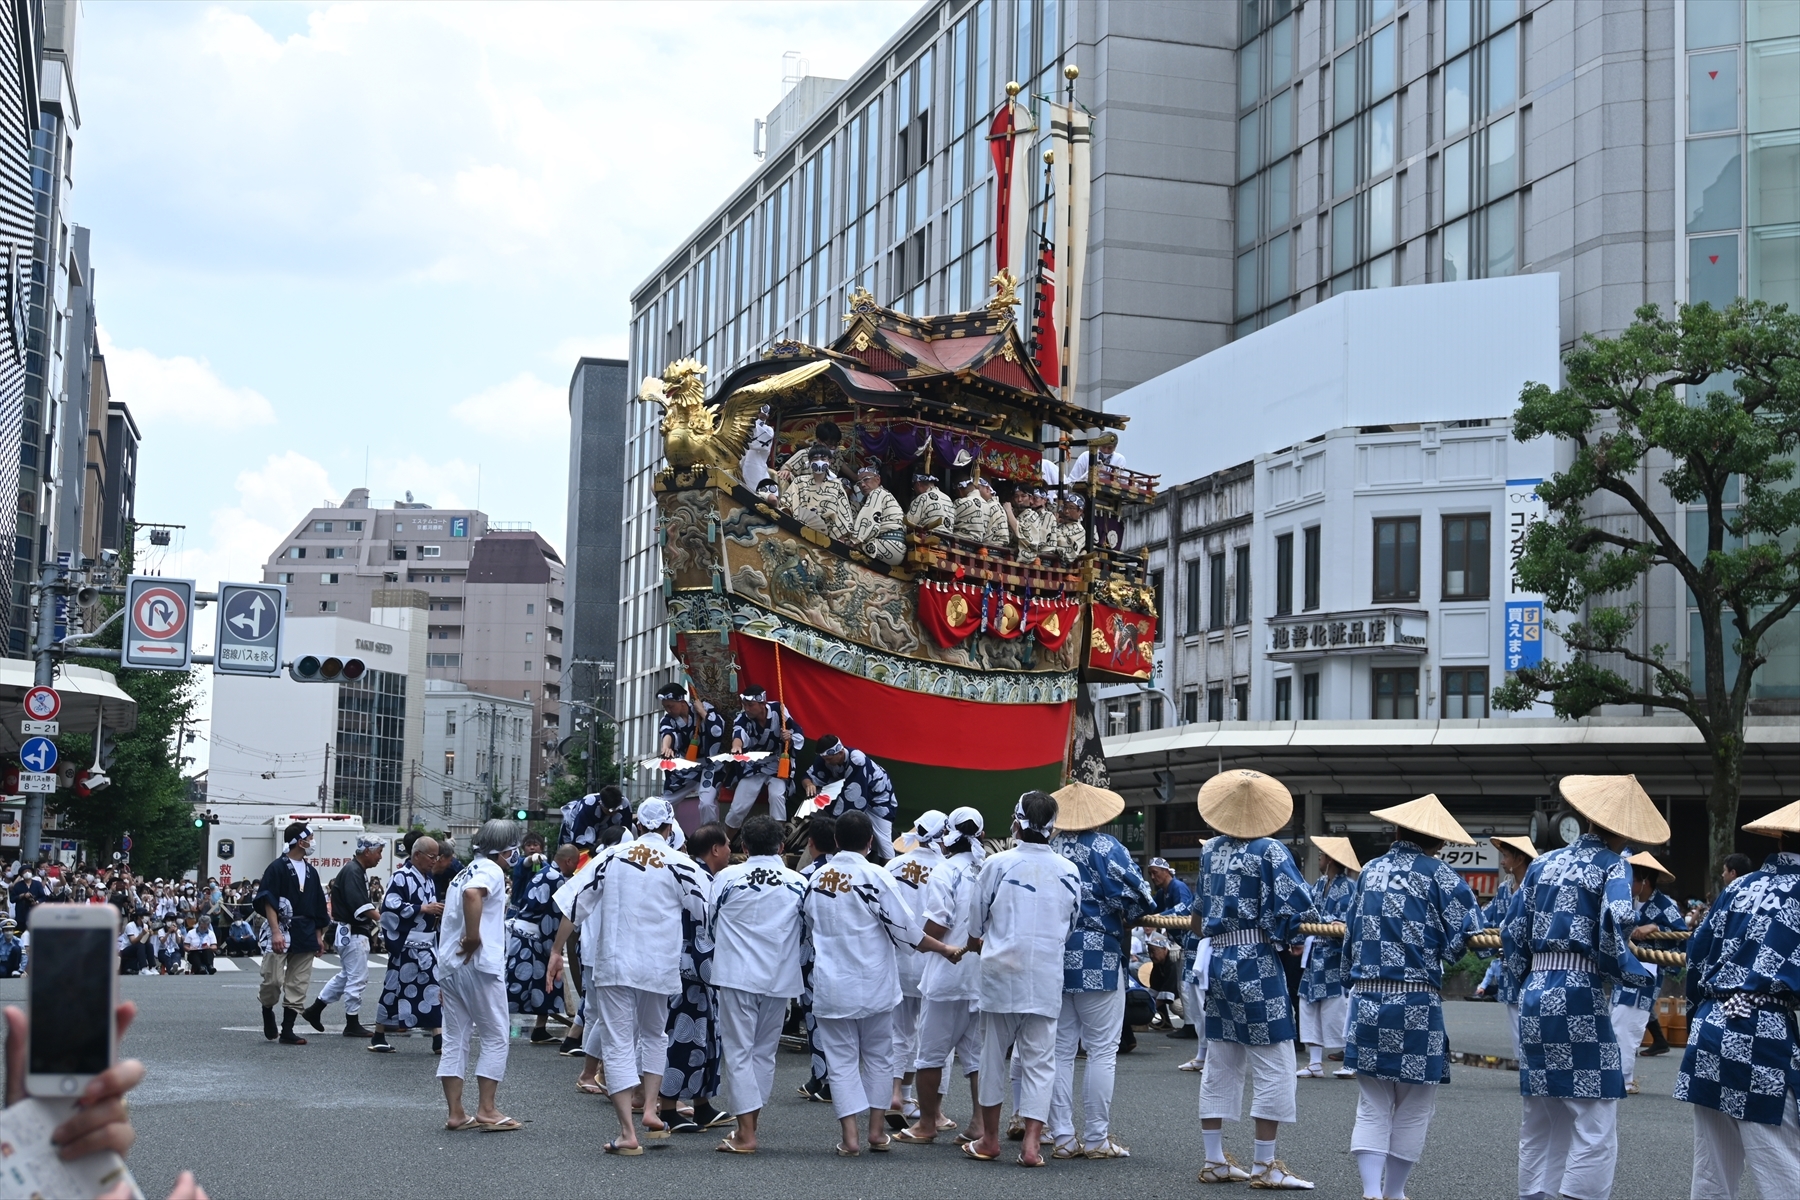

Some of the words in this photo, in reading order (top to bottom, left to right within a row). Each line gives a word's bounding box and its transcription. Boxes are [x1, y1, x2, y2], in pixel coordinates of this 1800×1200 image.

[1272, 620, 1386, 649] 池善化粧品店
[1508, 608, 1522, 669] 買えます
[1524, 608, 1538, 640] すぐ
[222, 648, 274, 662] 路線バスを除く
[20, 774, 55, 782] 路線バスを除く
